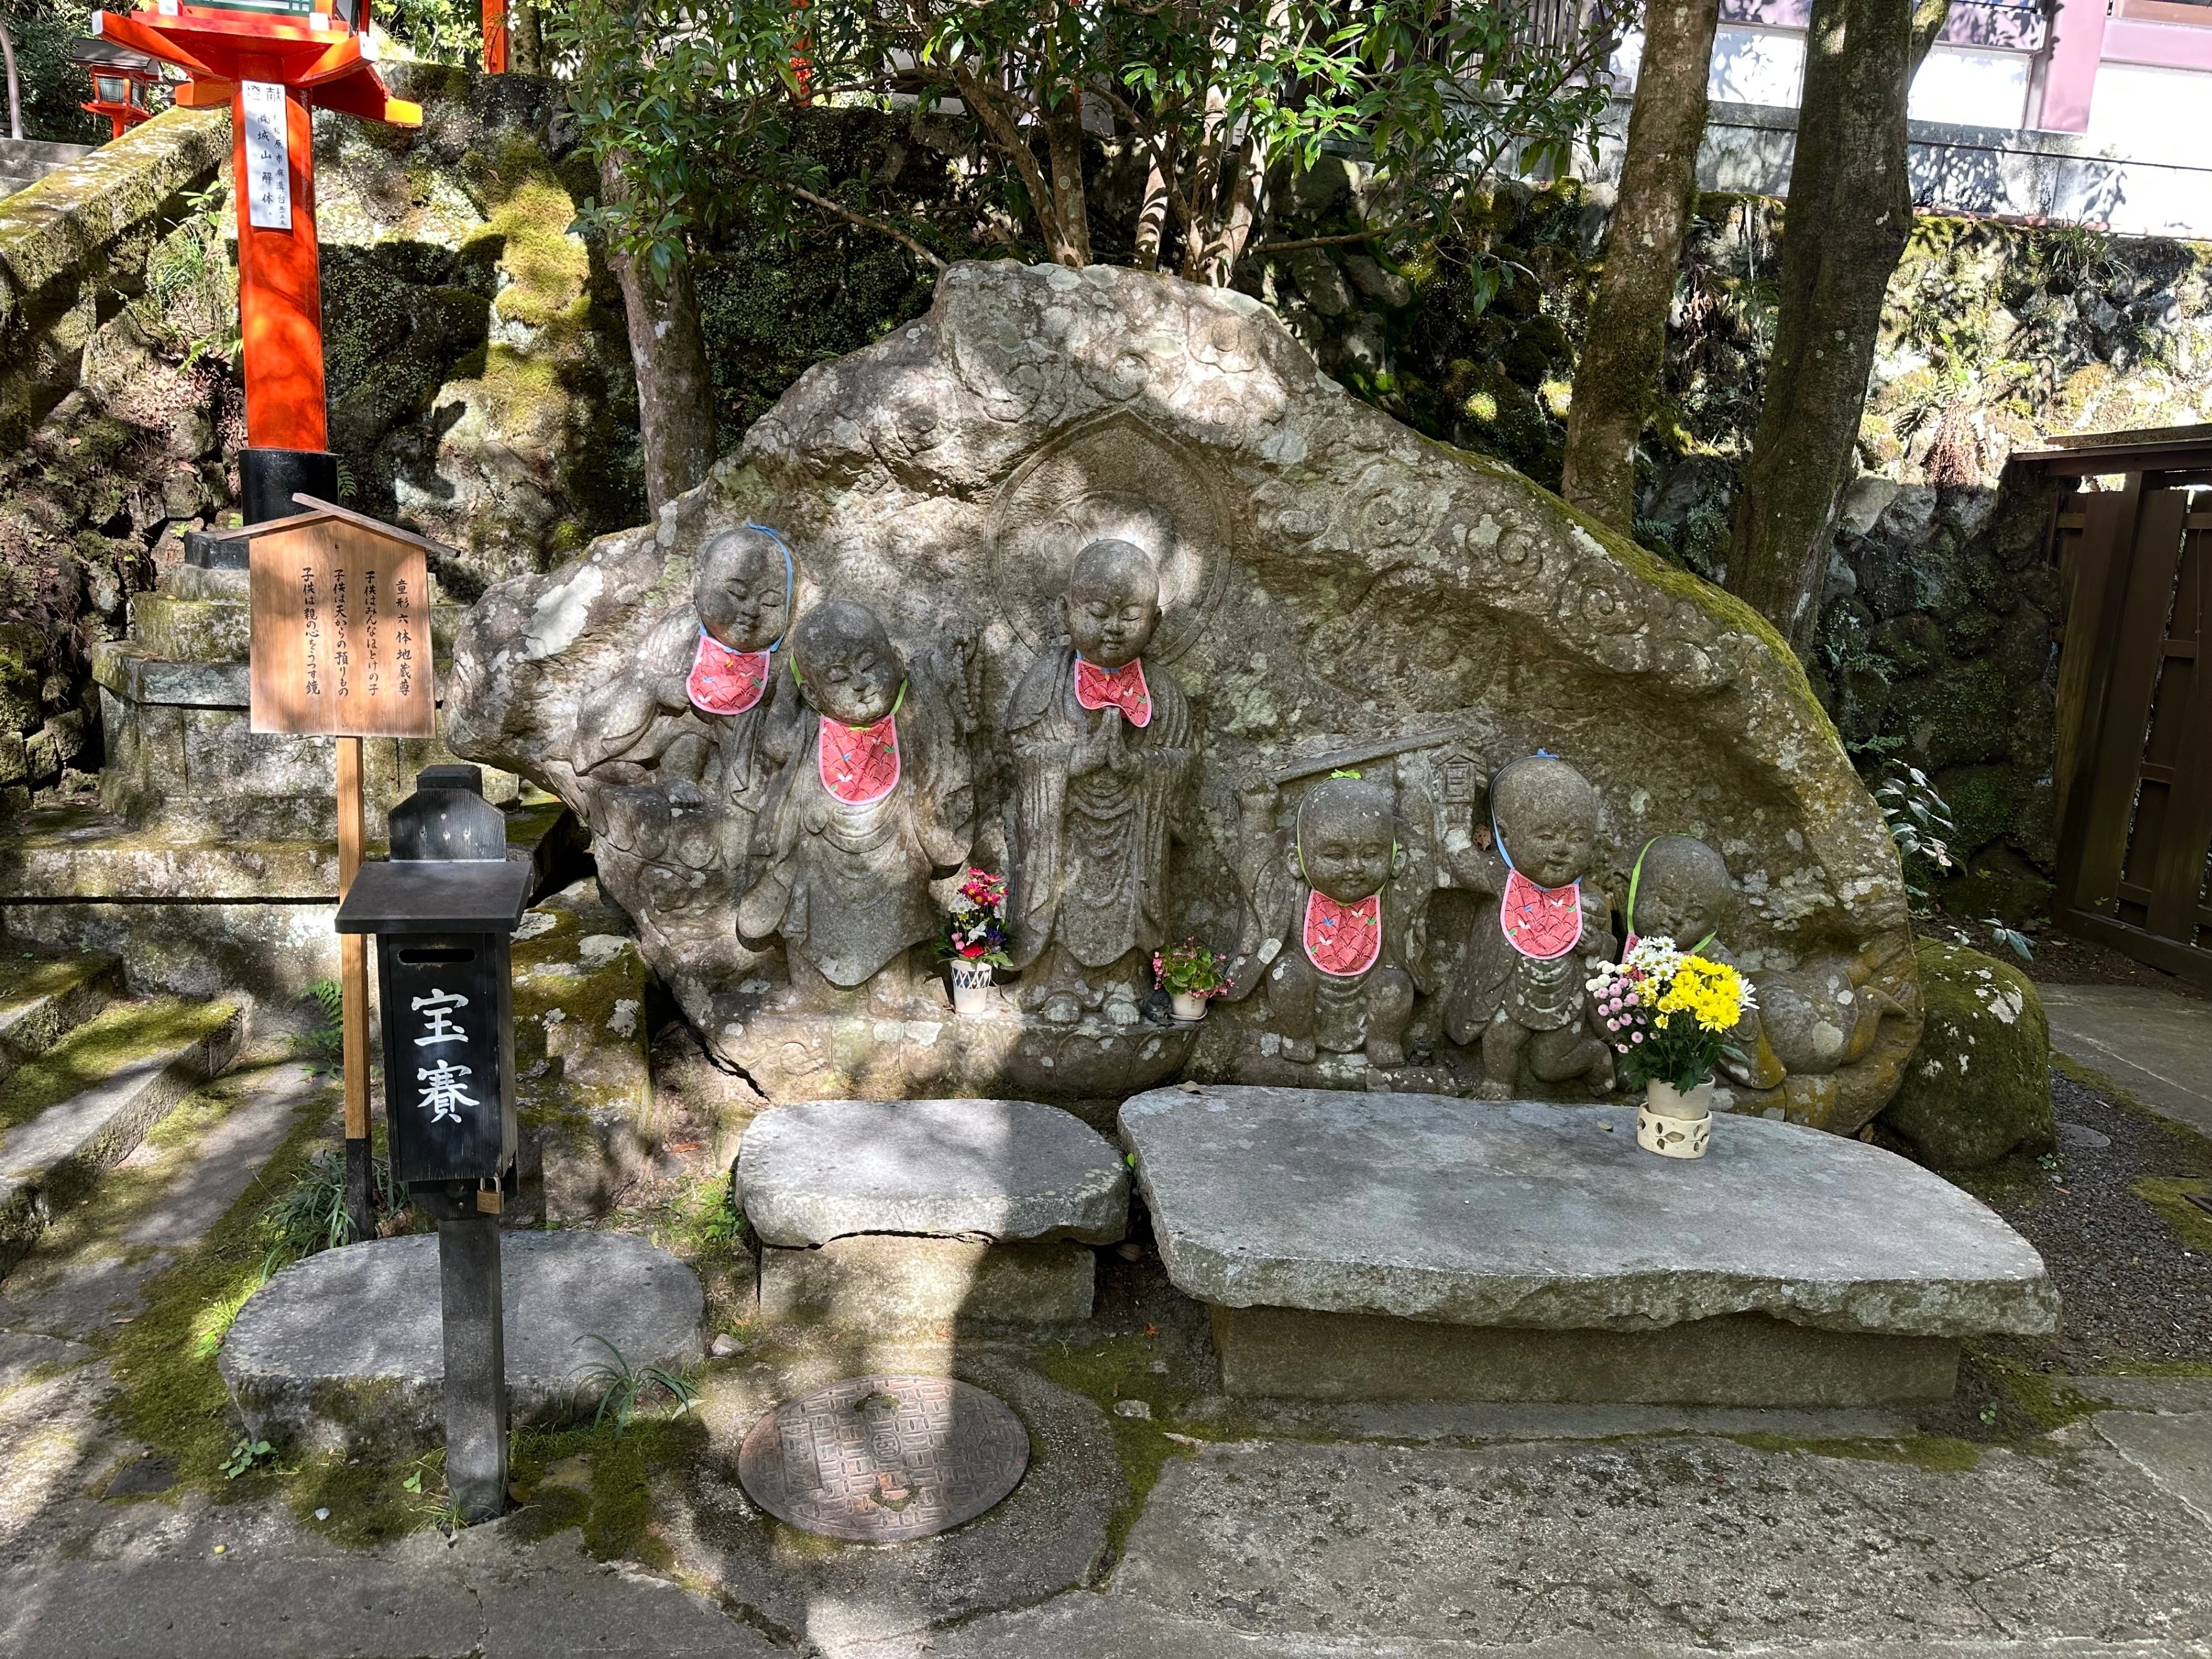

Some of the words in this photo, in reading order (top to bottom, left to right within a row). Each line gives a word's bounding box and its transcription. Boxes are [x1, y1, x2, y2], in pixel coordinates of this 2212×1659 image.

[301, 567, 321, 695] 子供は親の心をうつす鏡
[333, 569, 349, 697] 子供は天からの預りもの
[364, 571, 379, 696] 子供はみんなほとけの子
[396, 578, 412, 696] 童形六体地蔵尊
[874, 1434, 898, 1456] 450
